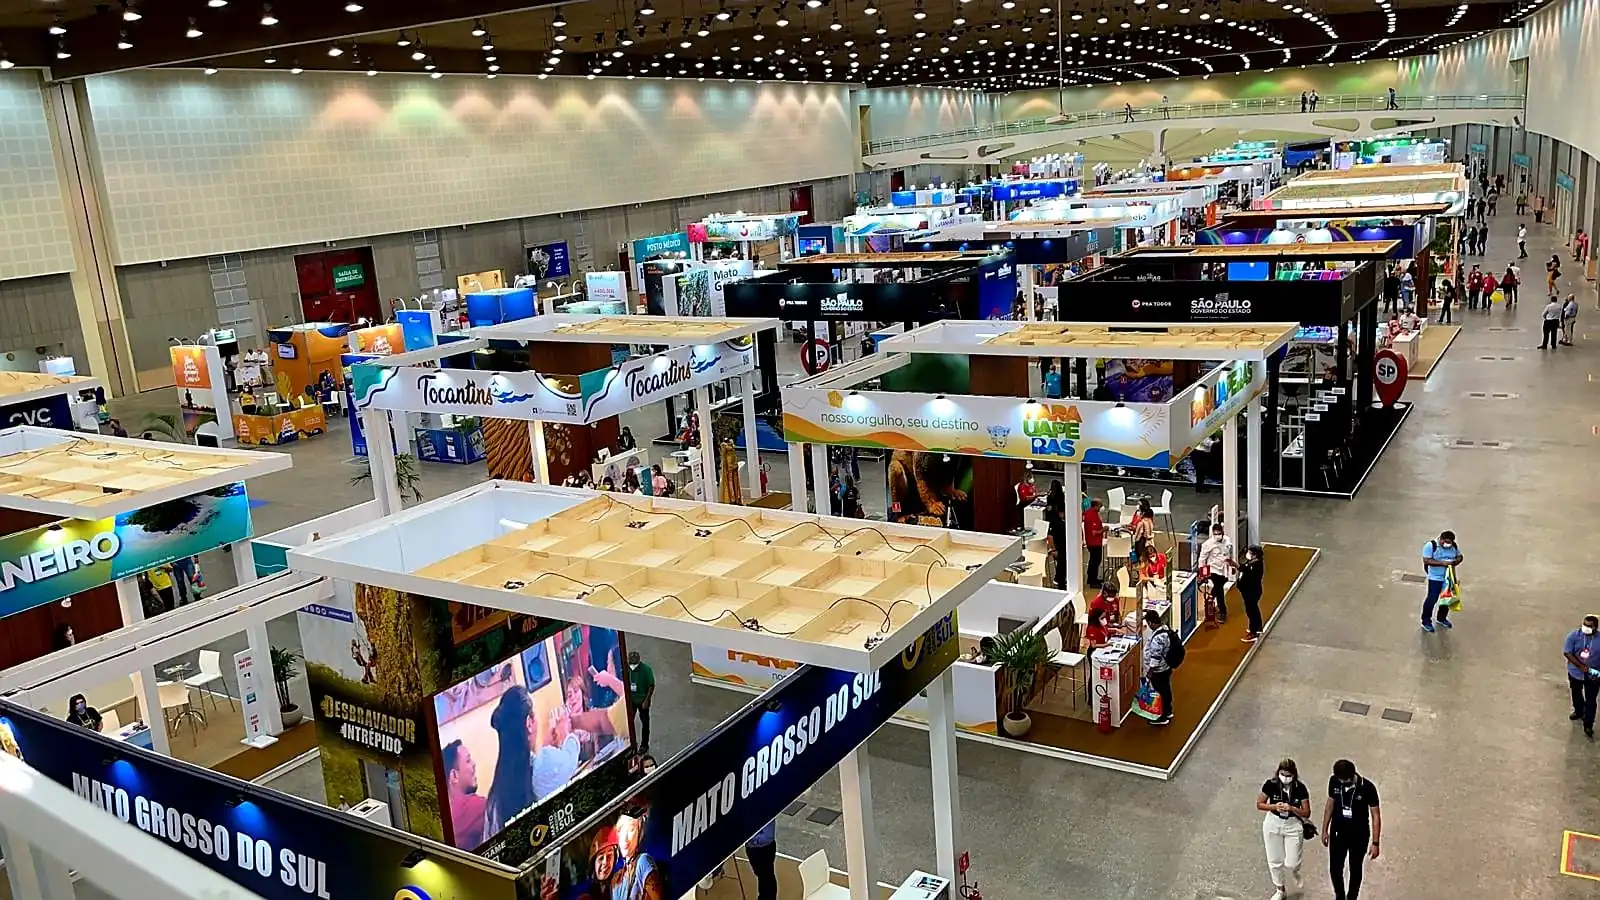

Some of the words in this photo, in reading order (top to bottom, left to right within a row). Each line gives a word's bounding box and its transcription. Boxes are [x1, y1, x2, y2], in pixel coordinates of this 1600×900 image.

[646, 243, 662, 252] POSTO
[663, 239, 681, 249] MÉDICO
[713, 268, 738, 281] Mato
[820, 297, 837, 307] SÃO
[837, 299, 863, 307] PAULO
[1191, 297, 1212, 309] SÃO
[1215, 300, 1251, 309] PAULO
[625, 359, 692, 401] Tocantins
[1378, 363, 1396, 378] SP
[417, 374, 493, 406] Tocantins
[821, 412, 854, 424] nosso
[857, 414, 905, 429] orgulho,
[907, 418, 929, 428] seu
[932, 417, 979, 431] destino
[320, 694, 416, 744] DESBRAVADOR
[340, 722, 403, 755] INTRÉPIDO
[671, 771, 736, 858] MATO
[741, 705, 821, 800] GROSSO
[825, 683, 849, 734] DO
[852, 668, 882, 710] SUL
[557, 802, 574, 821] DO
[559, 814, 576, 832] SUL
[72, 772, 129, 823] MATO
[134, 795, 229, 861] GROSSO
[236, 832, 273, 878] DO
[279, 848, 330, 899] SUL
